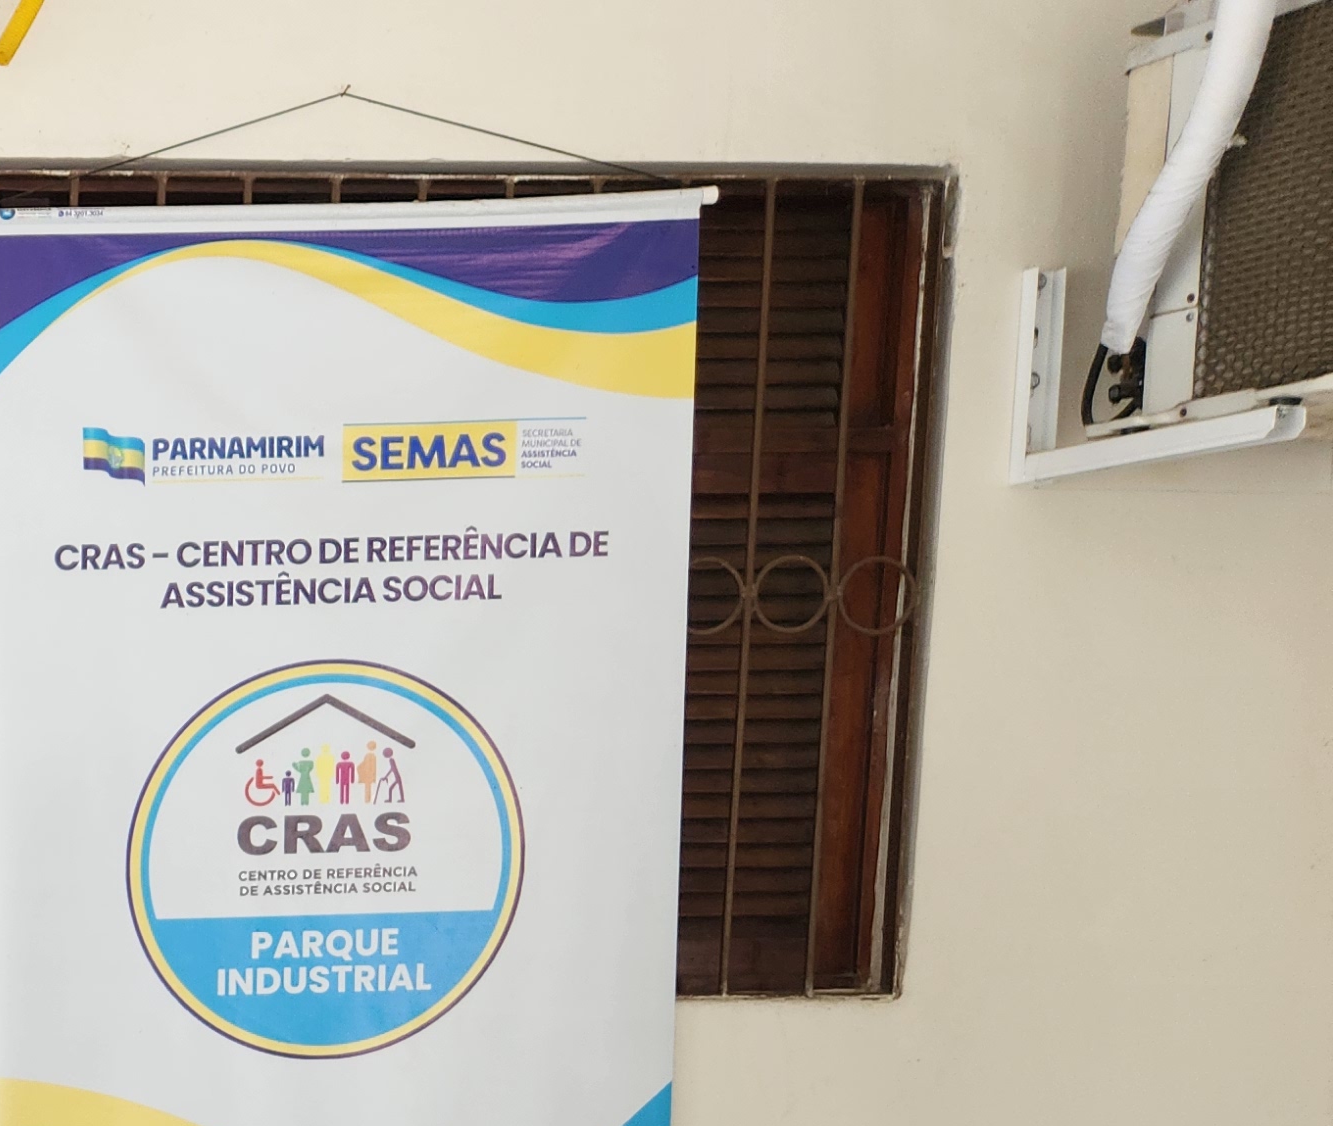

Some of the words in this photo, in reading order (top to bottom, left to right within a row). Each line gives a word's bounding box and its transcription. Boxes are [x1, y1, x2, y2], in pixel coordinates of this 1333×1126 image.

[521, 438, 569, 448] MUNICIPAL
[570, 438, 581, 448] DE
[522, 428, 574, 438] SECRETARIA
[152, 434, 325, 461] PARNAMIRIM
[352, 432, 506, 471] SEMAS
[521, 447, 577, 458] ASSISTÊNCIA
[152, 464, 234, 477] PREFEITURA
[239, 464, 256, 475] DO
[261, 463, 296, 475] POVO
[521, 460, 552, 469] SOCIAL
[55, 542, 146, 572] CRAS
[177, 535, 313, 568] CENTRO
[318, 535, 361, 565] DE
[365, 527, 562, 563] REFERÊNCIA
[568, 530, 610, 559] DE
[160, 573, 376, 610] ASSISTÊNCIA
[382, 574, 503, 603] SOCIAL
[237, 811, 412, 856] CRAS
[238, 868, 298, 882] CENTRO
[302, 867, 322, 881] DE
[326, 863, 418, 880] REFERÊNCIA
[239, 883, 258, 897] DE
[262, 879, 359, 896] ASSISTÊNCIA
[362, 880, 417, 893] SOCIAL
[251, 928, 400, 960] PARQUE
[216, 962, 432, 997] INDUSTRIAL
